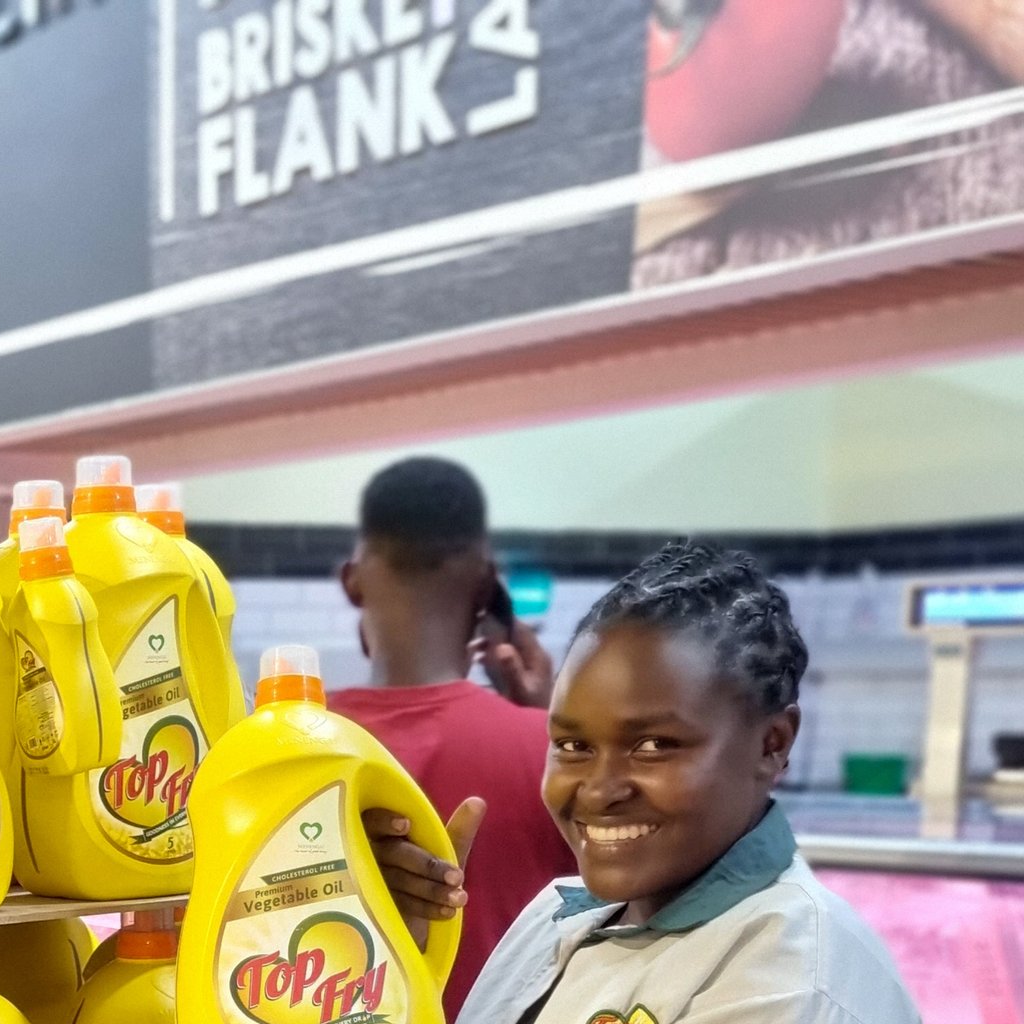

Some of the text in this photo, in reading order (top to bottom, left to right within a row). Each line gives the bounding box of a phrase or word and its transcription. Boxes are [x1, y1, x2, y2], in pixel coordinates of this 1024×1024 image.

[197, 30, 457, 217] FLANK
[123, 696, 163, 720] getable
[166, 687, 180, 702] Oil
[160, 763, 195, 819] Fr
[167, 837, 174, 850] 5
[272, 864, 335, 882] CHOLESTEROL FREE
[244, 880, 342, 913] Vegetable Oil
[256, 885, 292, 898] Premium
